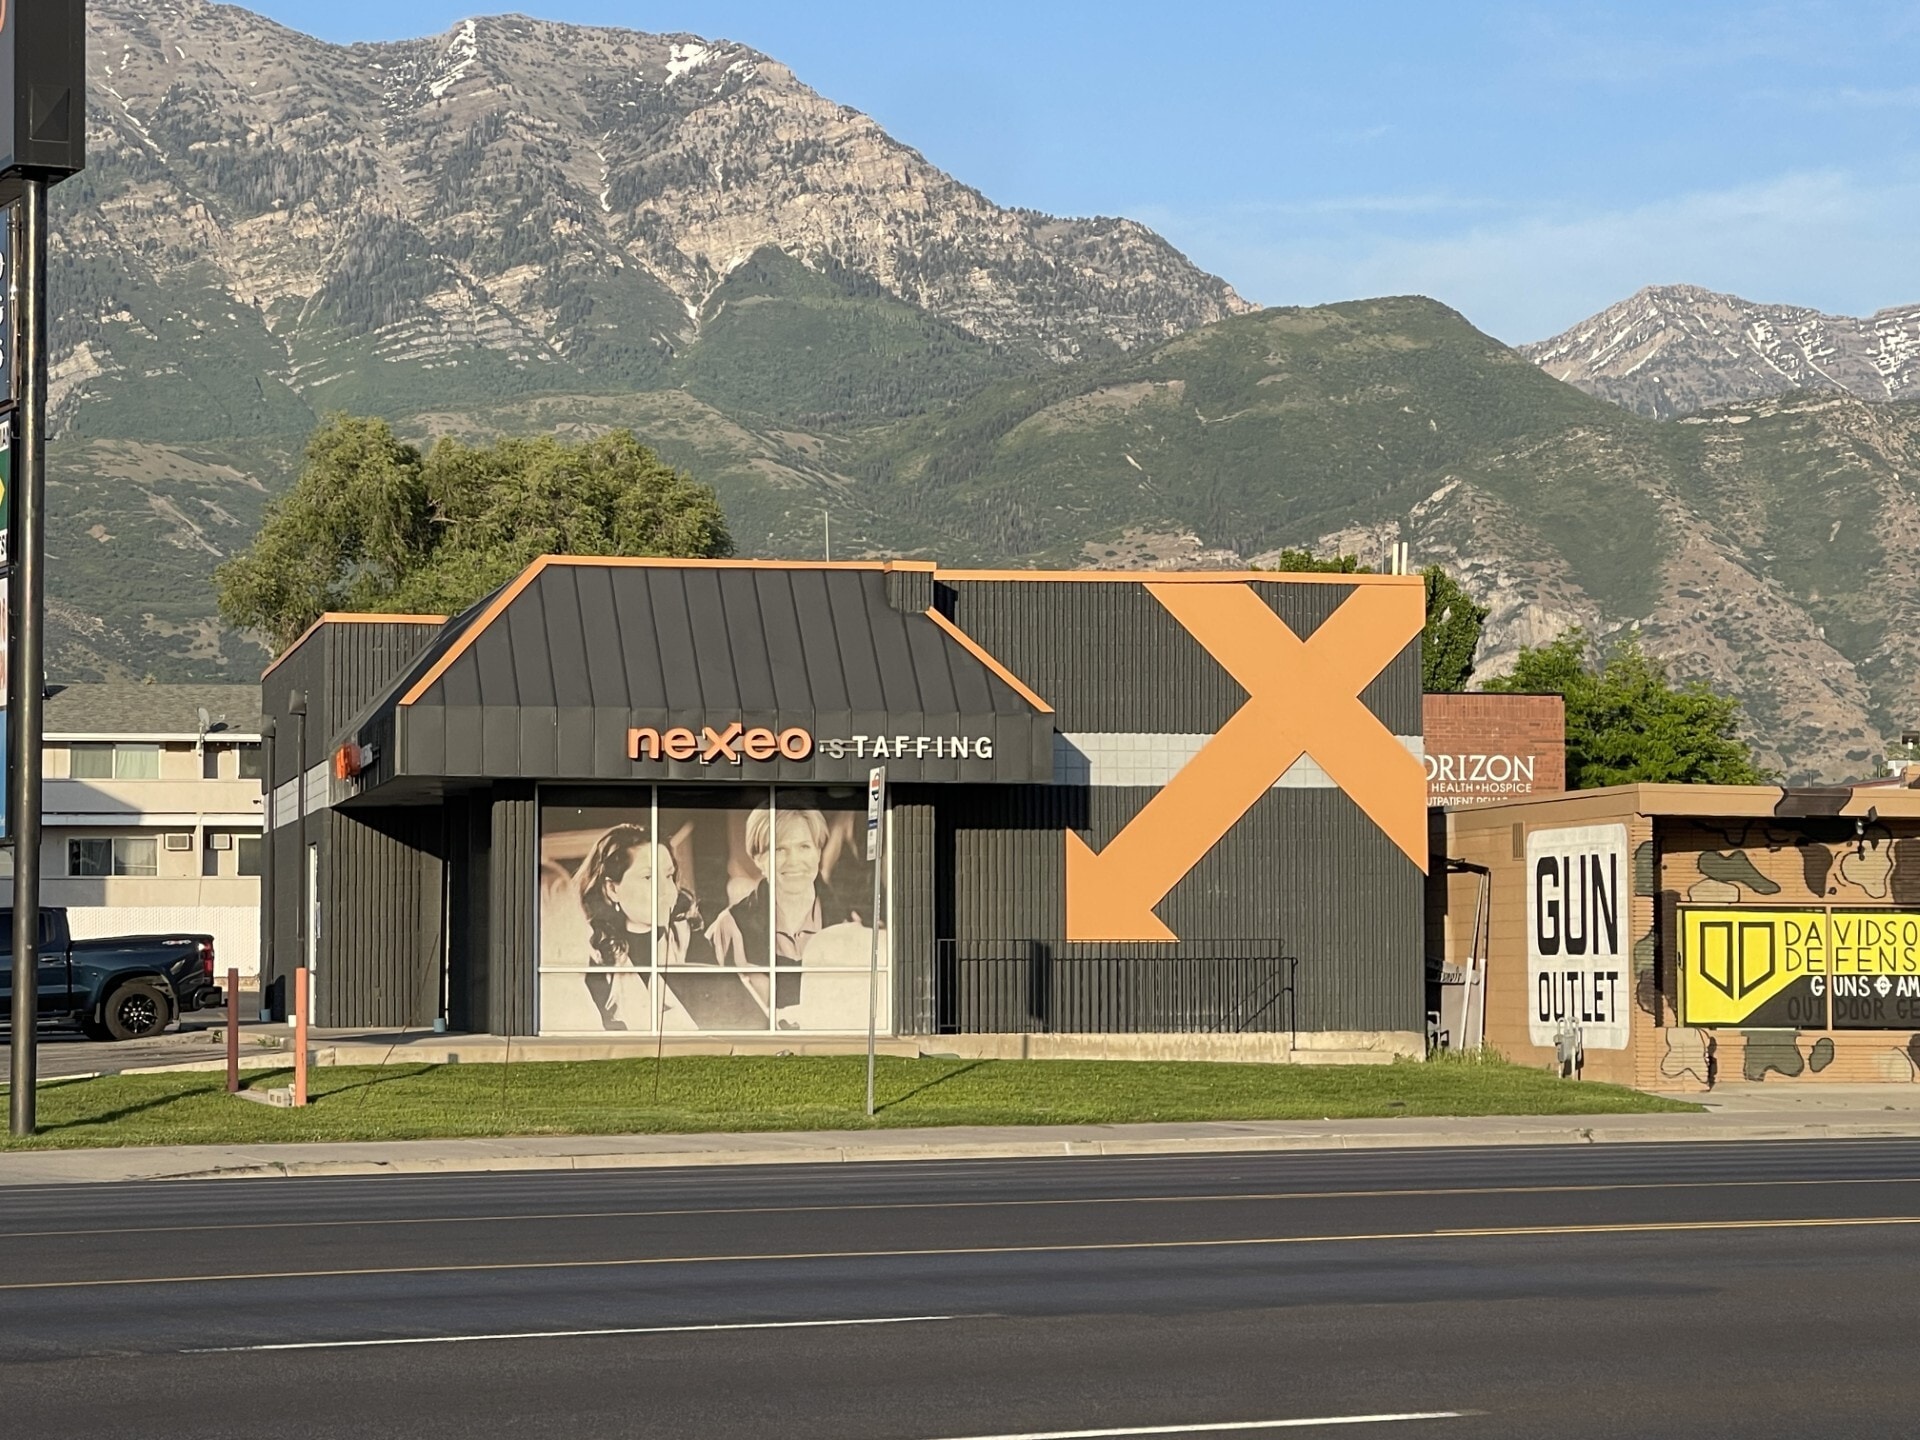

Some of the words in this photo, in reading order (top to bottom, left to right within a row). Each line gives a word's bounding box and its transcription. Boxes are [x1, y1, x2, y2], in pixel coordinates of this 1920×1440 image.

[628, 722, 813, 764] nexeo
[829, 735, 993, 759] STAFFING
[1431, 782, 1474, 793] HEALTH
[1481, 782, 1532, 793] HOSPICE
[1536, 853, 1618, 956] GUN
[1538, 971, 1618, 1022] OUTLET
[1810, 975, 1871, 997] GUNS
